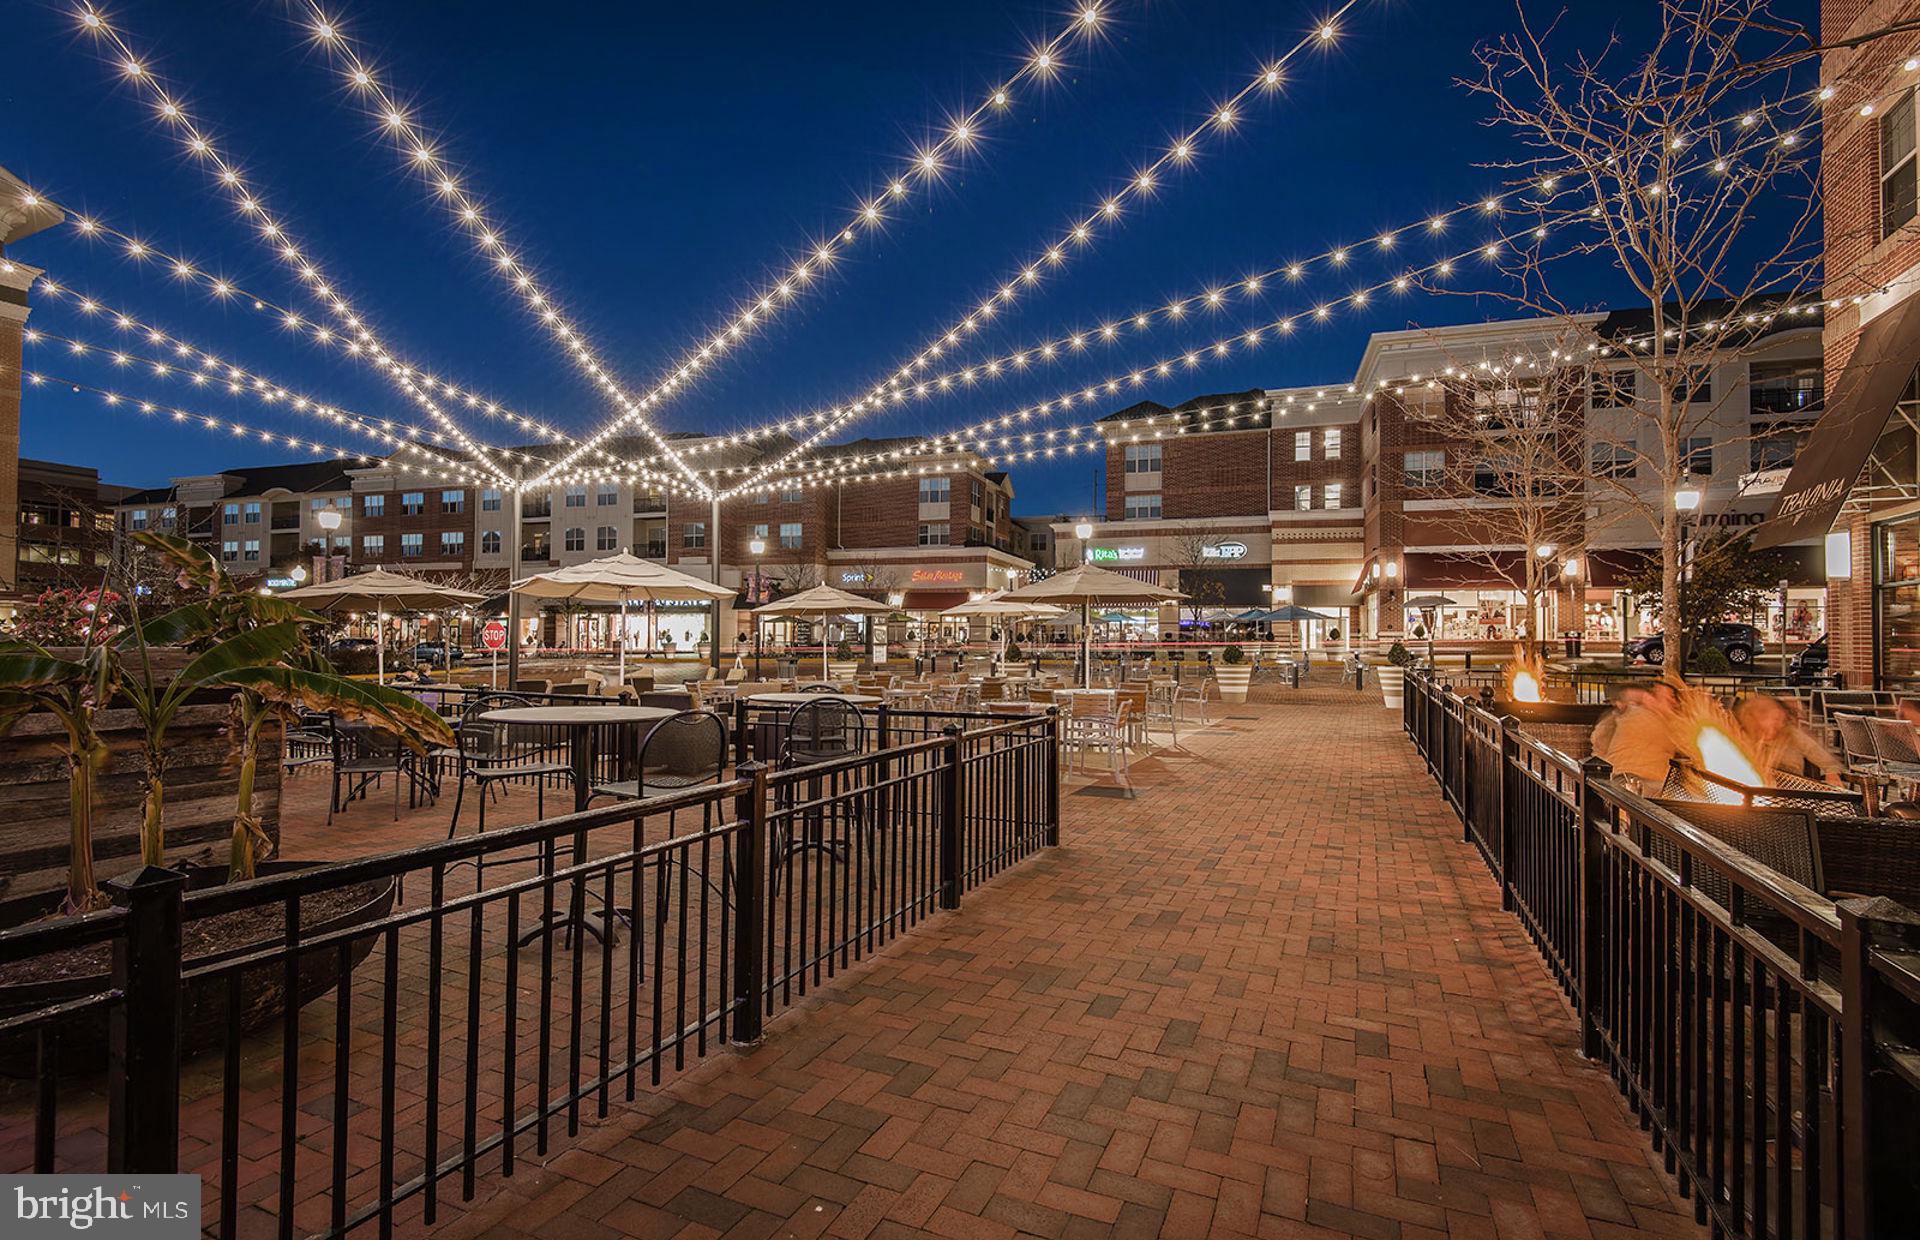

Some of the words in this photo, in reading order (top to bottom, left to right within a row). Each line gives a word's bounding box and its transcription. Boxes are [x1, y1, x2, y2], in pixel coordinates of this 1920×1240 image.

[1777, 478, 1845, 515] TRAVINIA
[1095, 548, 1118, 561] Rita's
[842, 572, 865, 583] Sprint
[485, 629, 505, 641] STOP
